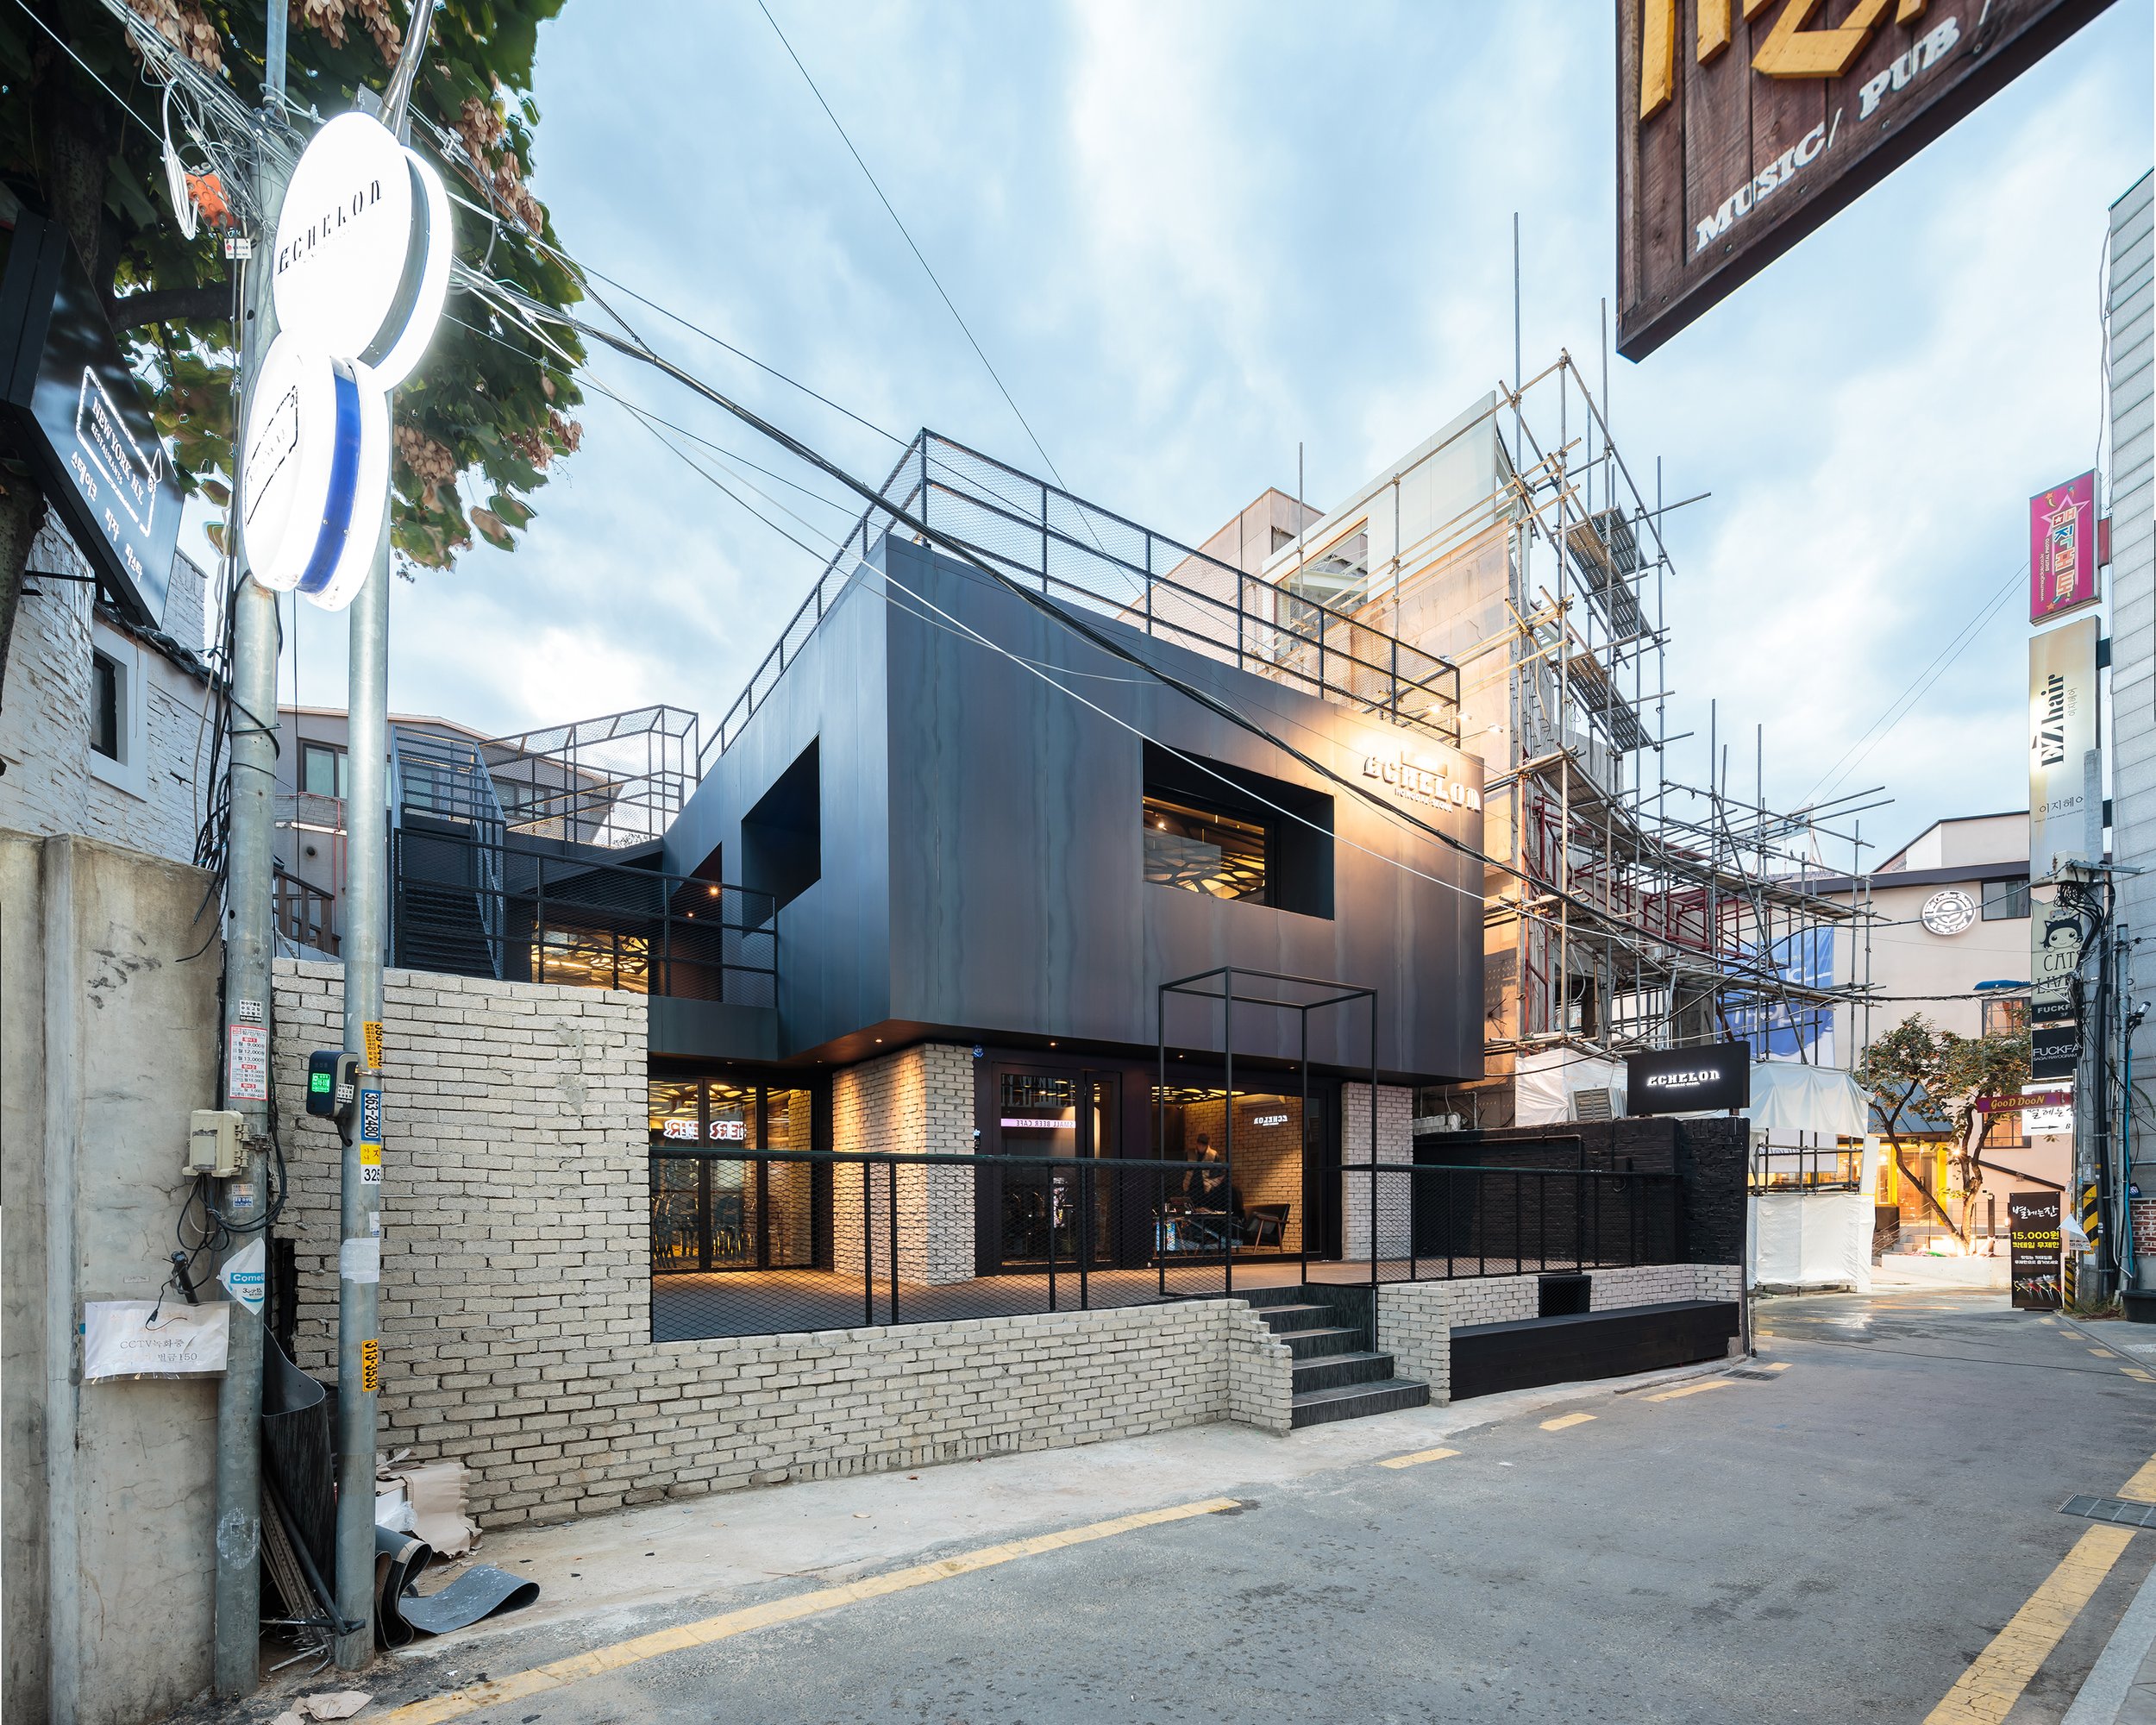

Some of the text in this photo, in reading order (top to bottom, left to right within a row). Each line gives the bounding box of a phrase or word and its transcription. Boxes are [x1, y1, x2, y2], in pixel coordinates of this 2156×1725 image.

[1858, 16, 1961, 121] PUB
[91, 422, 123, 486] RESTAURANTS
[92, 397, 145, 505] NEW YORK NY
[71, 451, 143, 583] 스테이크 피자 파스타
[2037, 1004, 2071, 1014] FUCKF
[365, 1093, 379, 1138] 363-2480
[2012, 1231, 2059, 1239] 15,000원
[365, 1342, 378, 1389] 313-3533
